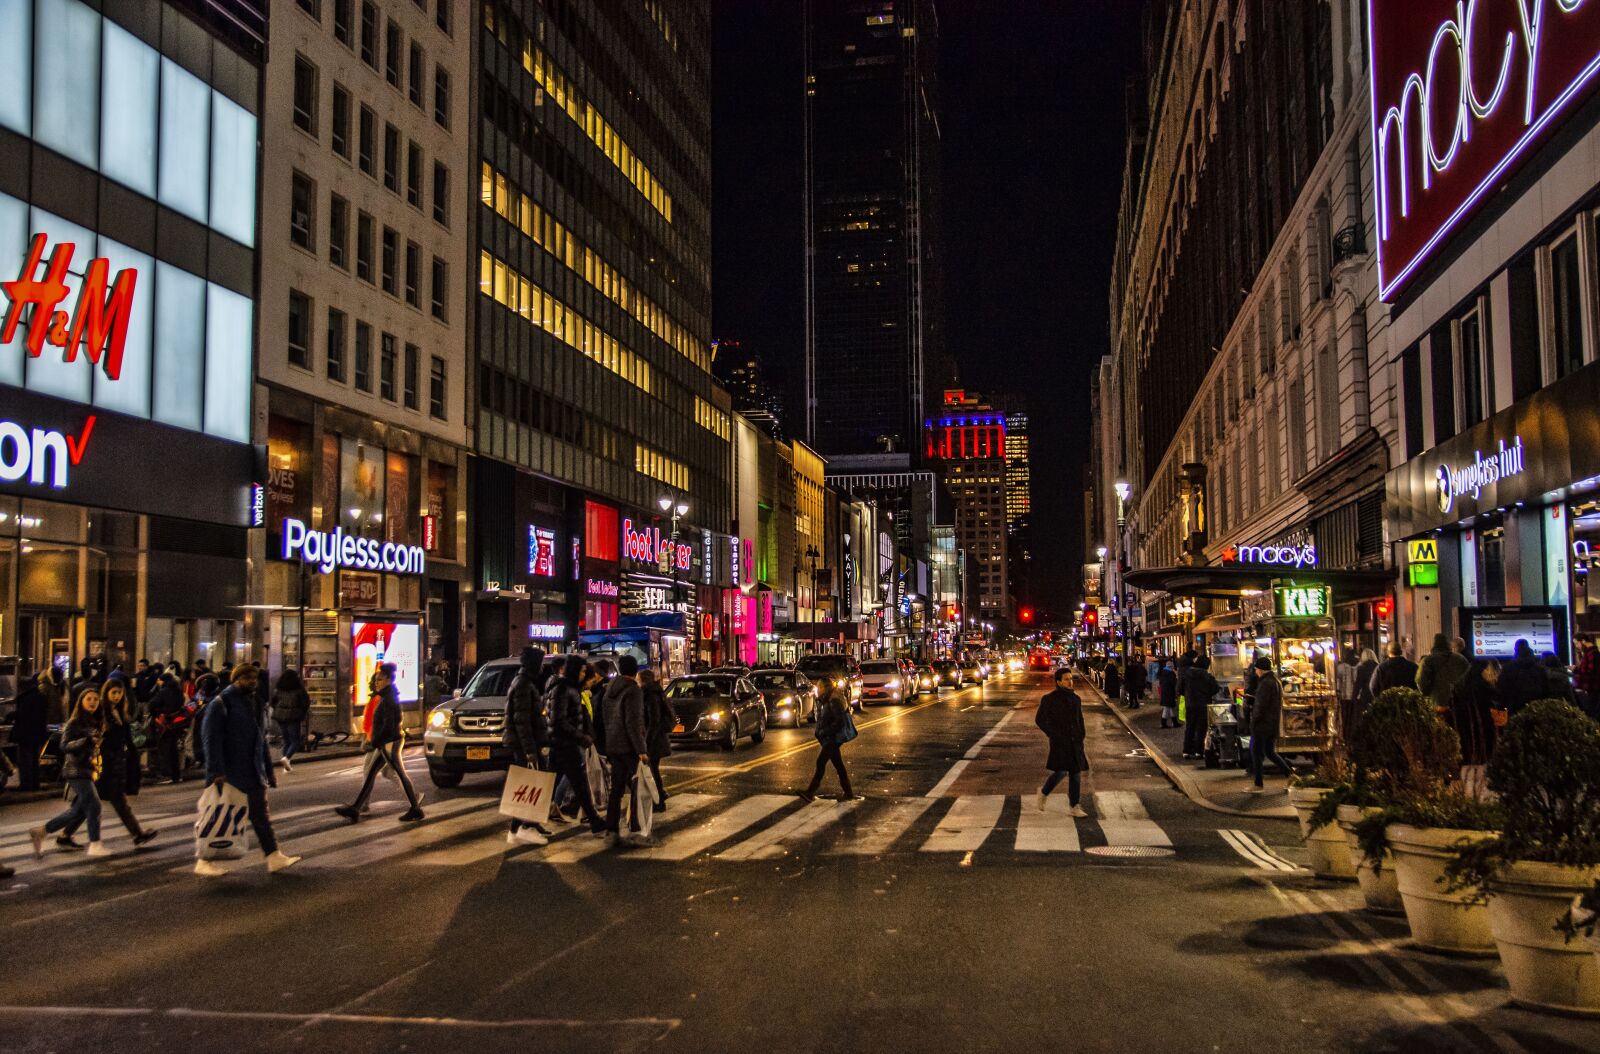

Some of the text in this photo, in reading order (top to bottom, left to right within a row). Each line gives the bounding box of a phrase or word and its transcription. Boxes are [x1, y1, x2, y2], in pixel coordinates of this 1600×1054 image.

[1, 232, 137, 381] H&M
[1452, 434, 1523, 501] sunglass hut
[253, 486, 264, 527] verizon
[283, 518, 426, 575] Payless.com
[624, 518, 652, 562] Foot
[1237, 544, 1317, 568] macy's
